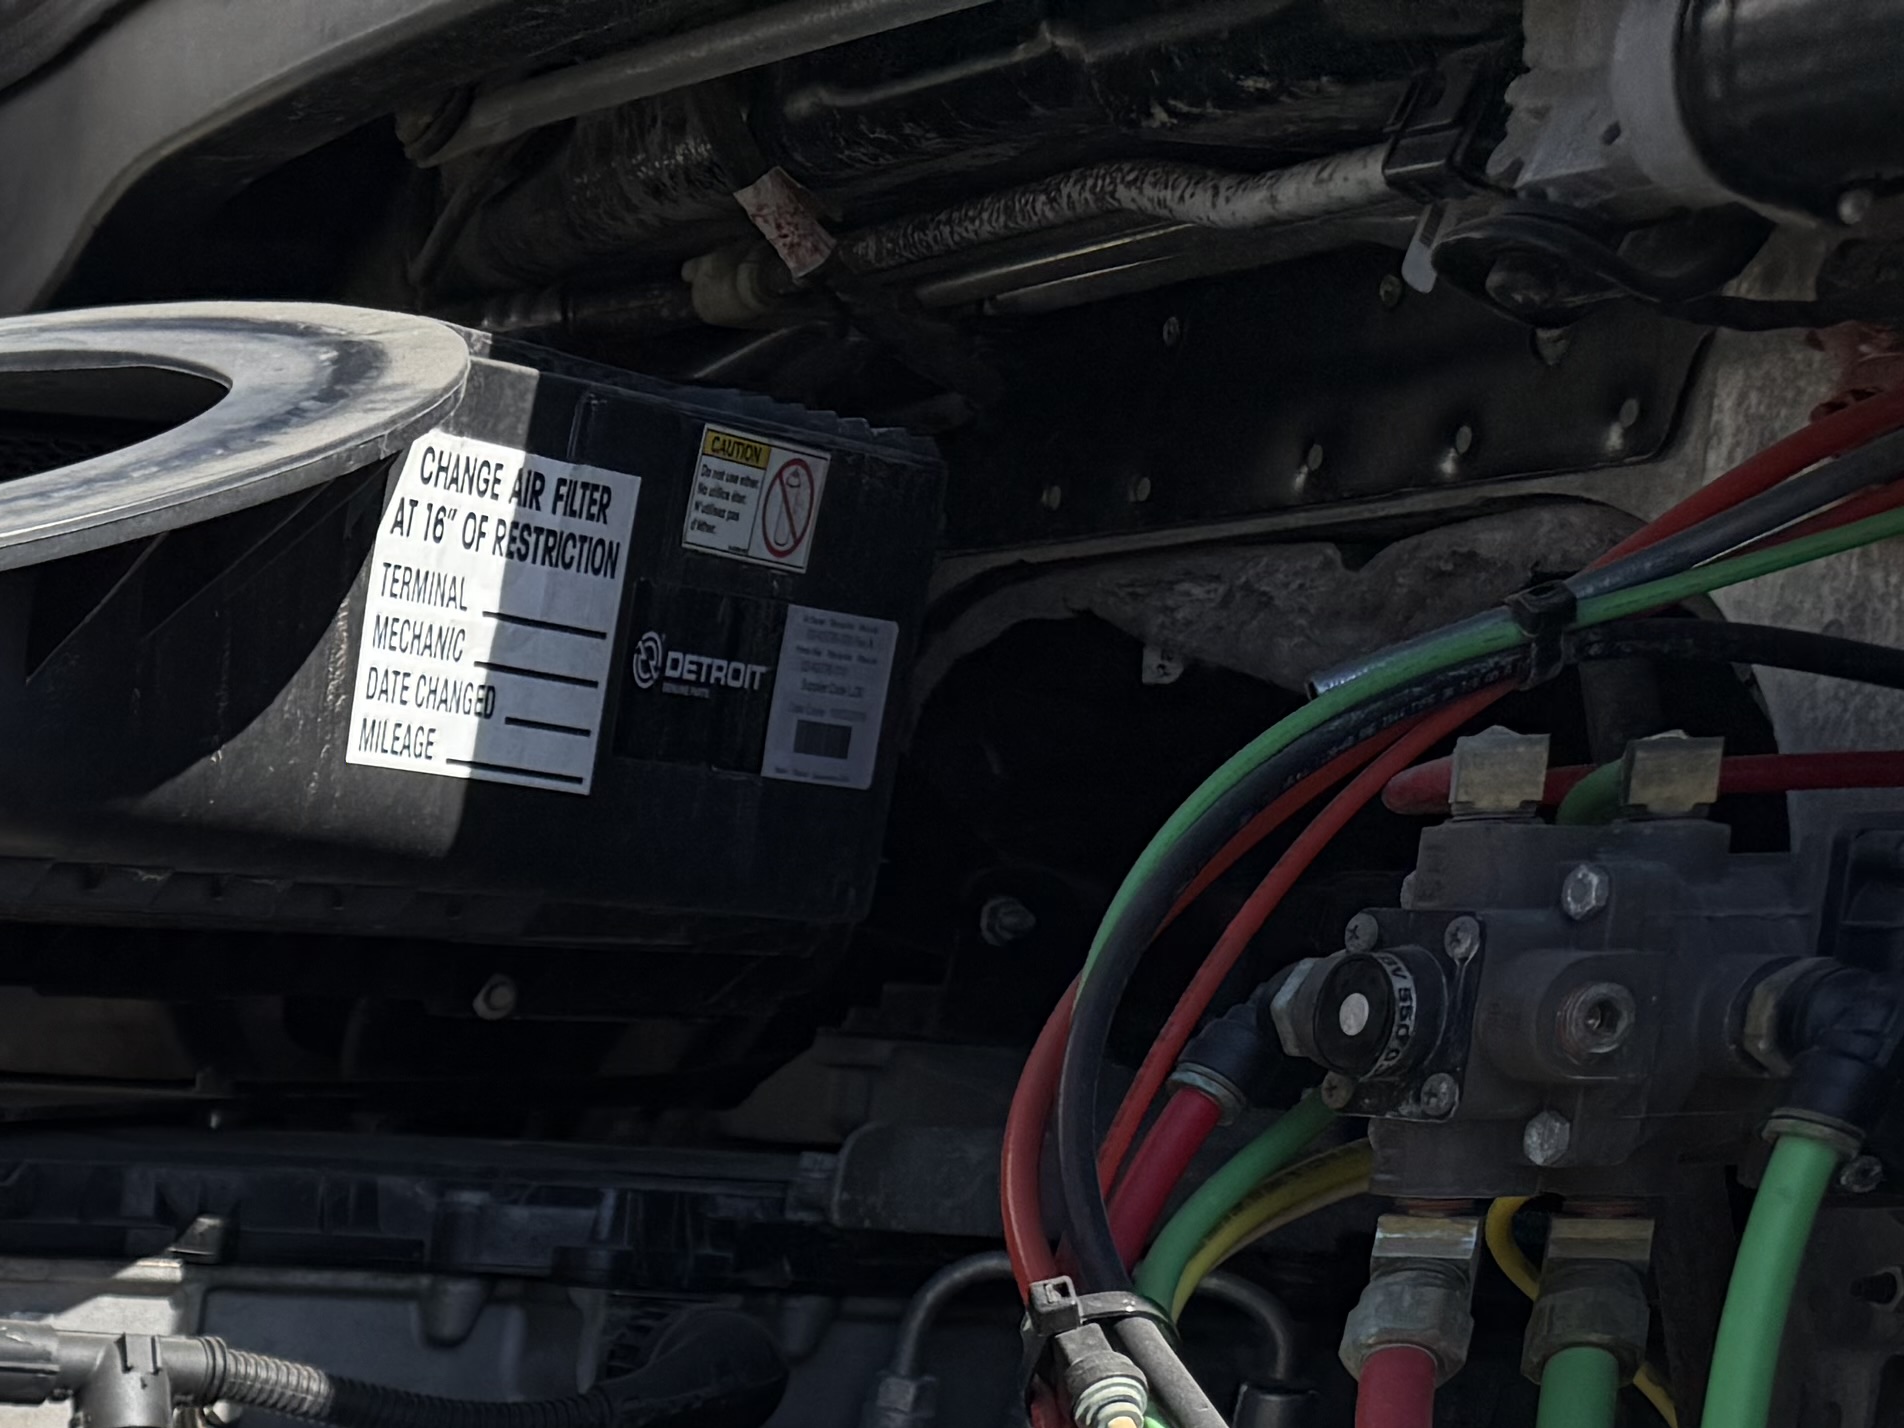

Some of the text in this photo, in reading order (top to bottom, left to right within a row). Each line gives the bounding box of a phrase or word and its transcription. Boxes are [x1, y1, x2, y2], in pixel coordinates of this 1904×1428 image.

[711, 436, 763, 464] CAUTION
[420, 446, 613, 525] CHANGE AIR FILTER
[390, 496, 419, 538] AT
[462, 511, 489, 553] OF
[492, 518, 621, 580] RESTRICTION
[380, 562, 468, 612] TERMINAL
[372, 614, 467, 663] MECHANIC
[366, 666, 497, 720] DATE CHANGED
[664, 650, 769, 690] DETROIT
[359, 717, 437, 761] MILEAGE
